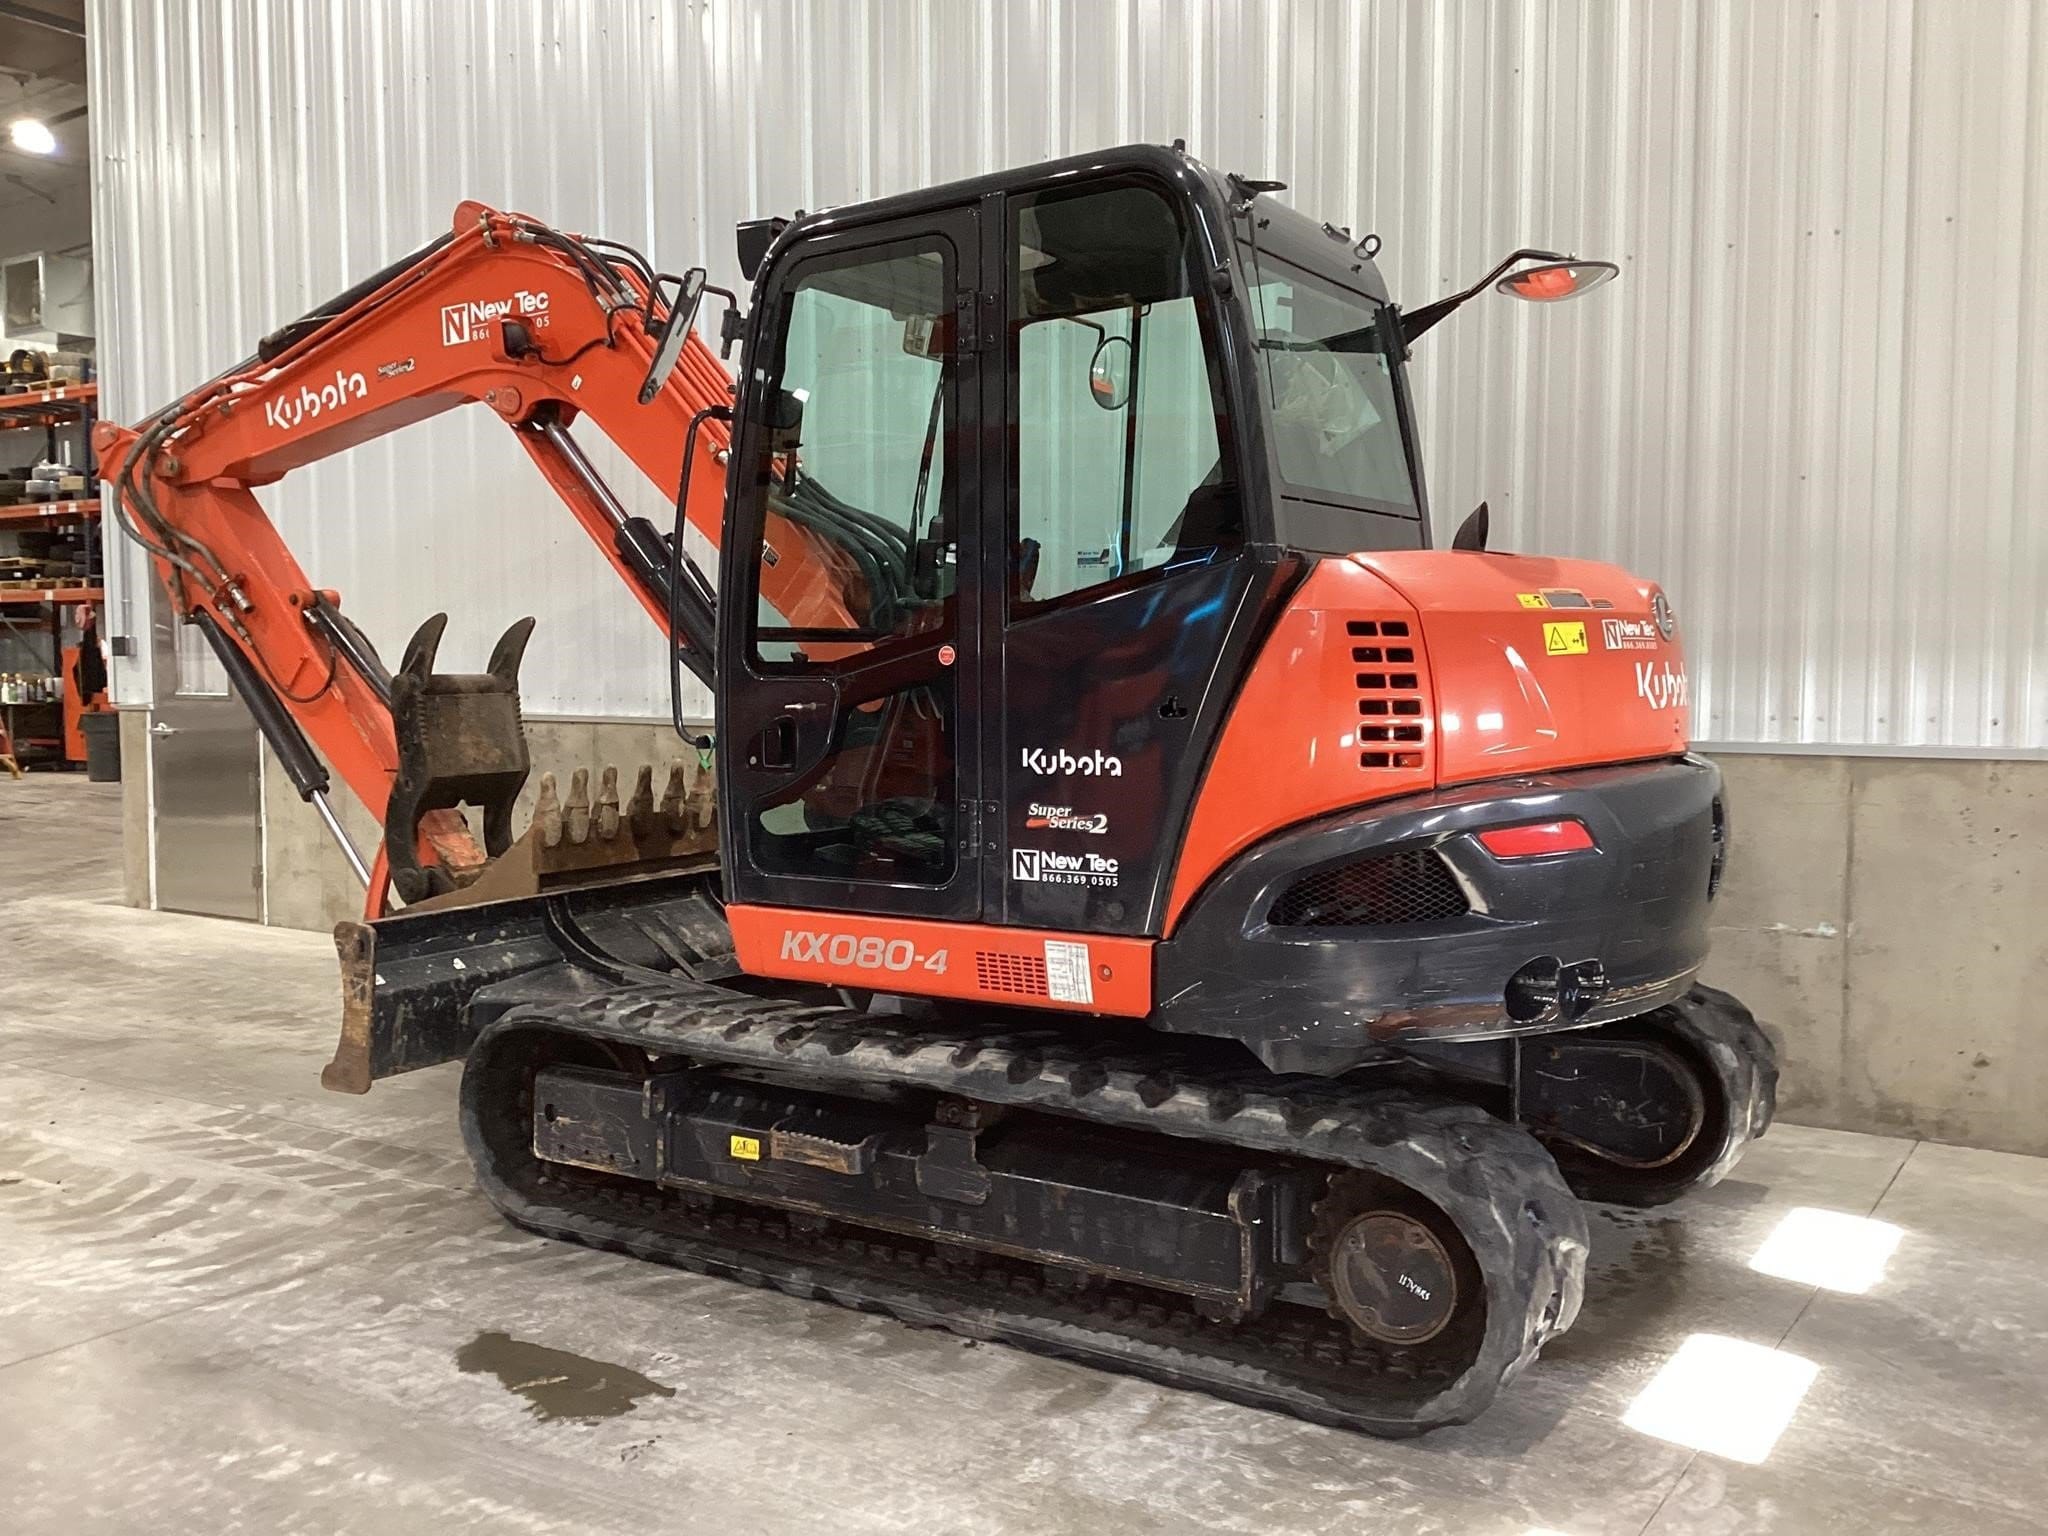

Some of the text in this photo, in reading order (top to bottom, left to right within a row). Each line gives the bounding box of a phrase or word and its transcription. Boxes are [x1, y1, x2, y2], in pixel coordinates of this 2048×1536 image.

[470, 299, 514, 324] New
[514, 290, 550, 314] Tec
[265, 369, 369, 431] Kubota
[1619, 619, 1641, 636] New
[1640, 620, 1656, 637] Tec
[1022, 747, 1122, 777] Kubota
[1028, 802, 1073, 819] Super
[1041, 851, 1084, 870] New
[1085, 853, 1119, 873] Tec
[1041, 873, 1119, 888] 866.369.0505
[780, 930, 949, 975] KX080-4
